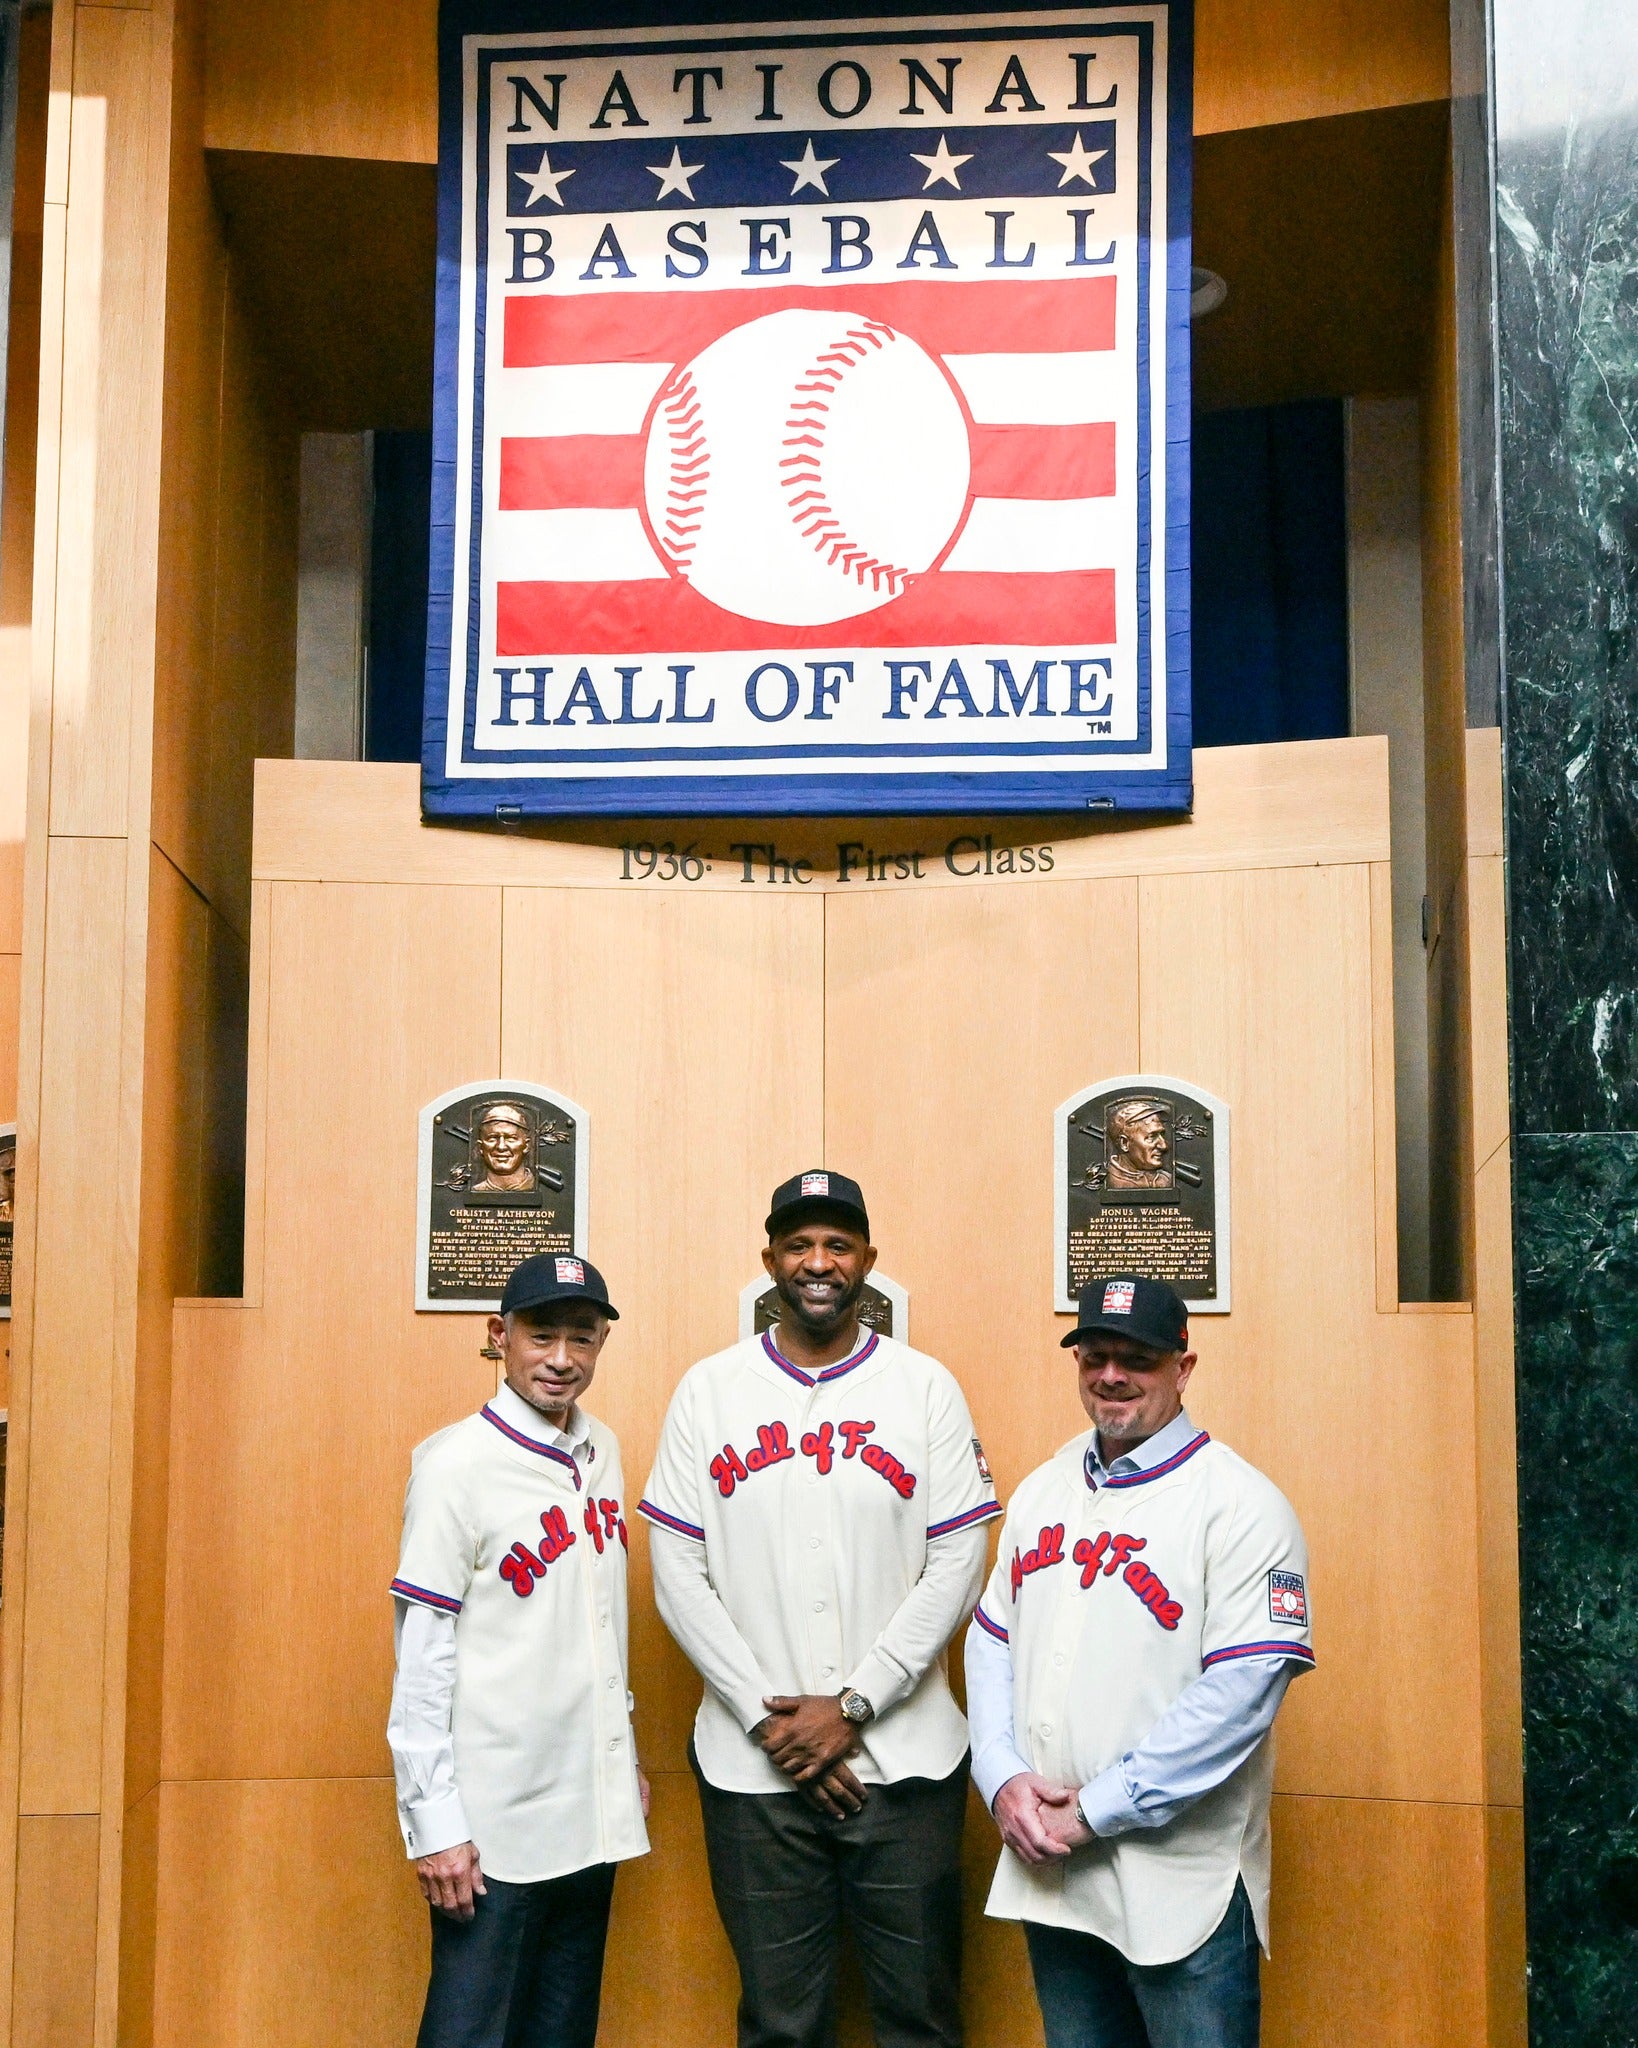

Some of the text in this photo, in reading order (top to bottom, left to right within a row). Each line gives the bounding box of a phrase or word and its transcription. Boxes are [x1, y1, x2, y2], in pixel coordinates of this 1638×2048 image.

[506, 53, 1118, 132] NATIONAL
[505, 209, 1117, 284] BASEBALL
[491, 658, 1112, 725] HALL OF FAME
[619, 834, 1055, 884] 1936: The First Class
[449, 1209, 555, 1218] CHRISTY MATHEWSON
[1101, 1208, 1134, 1216] HONUS
[710, 1420, 917, 1499] Hall of Fame
[499, 1505, 577, 1598] Hall
[1073, 1531, 1112, 1589] of
[1103, 1533, 1184, 1631] Fame
